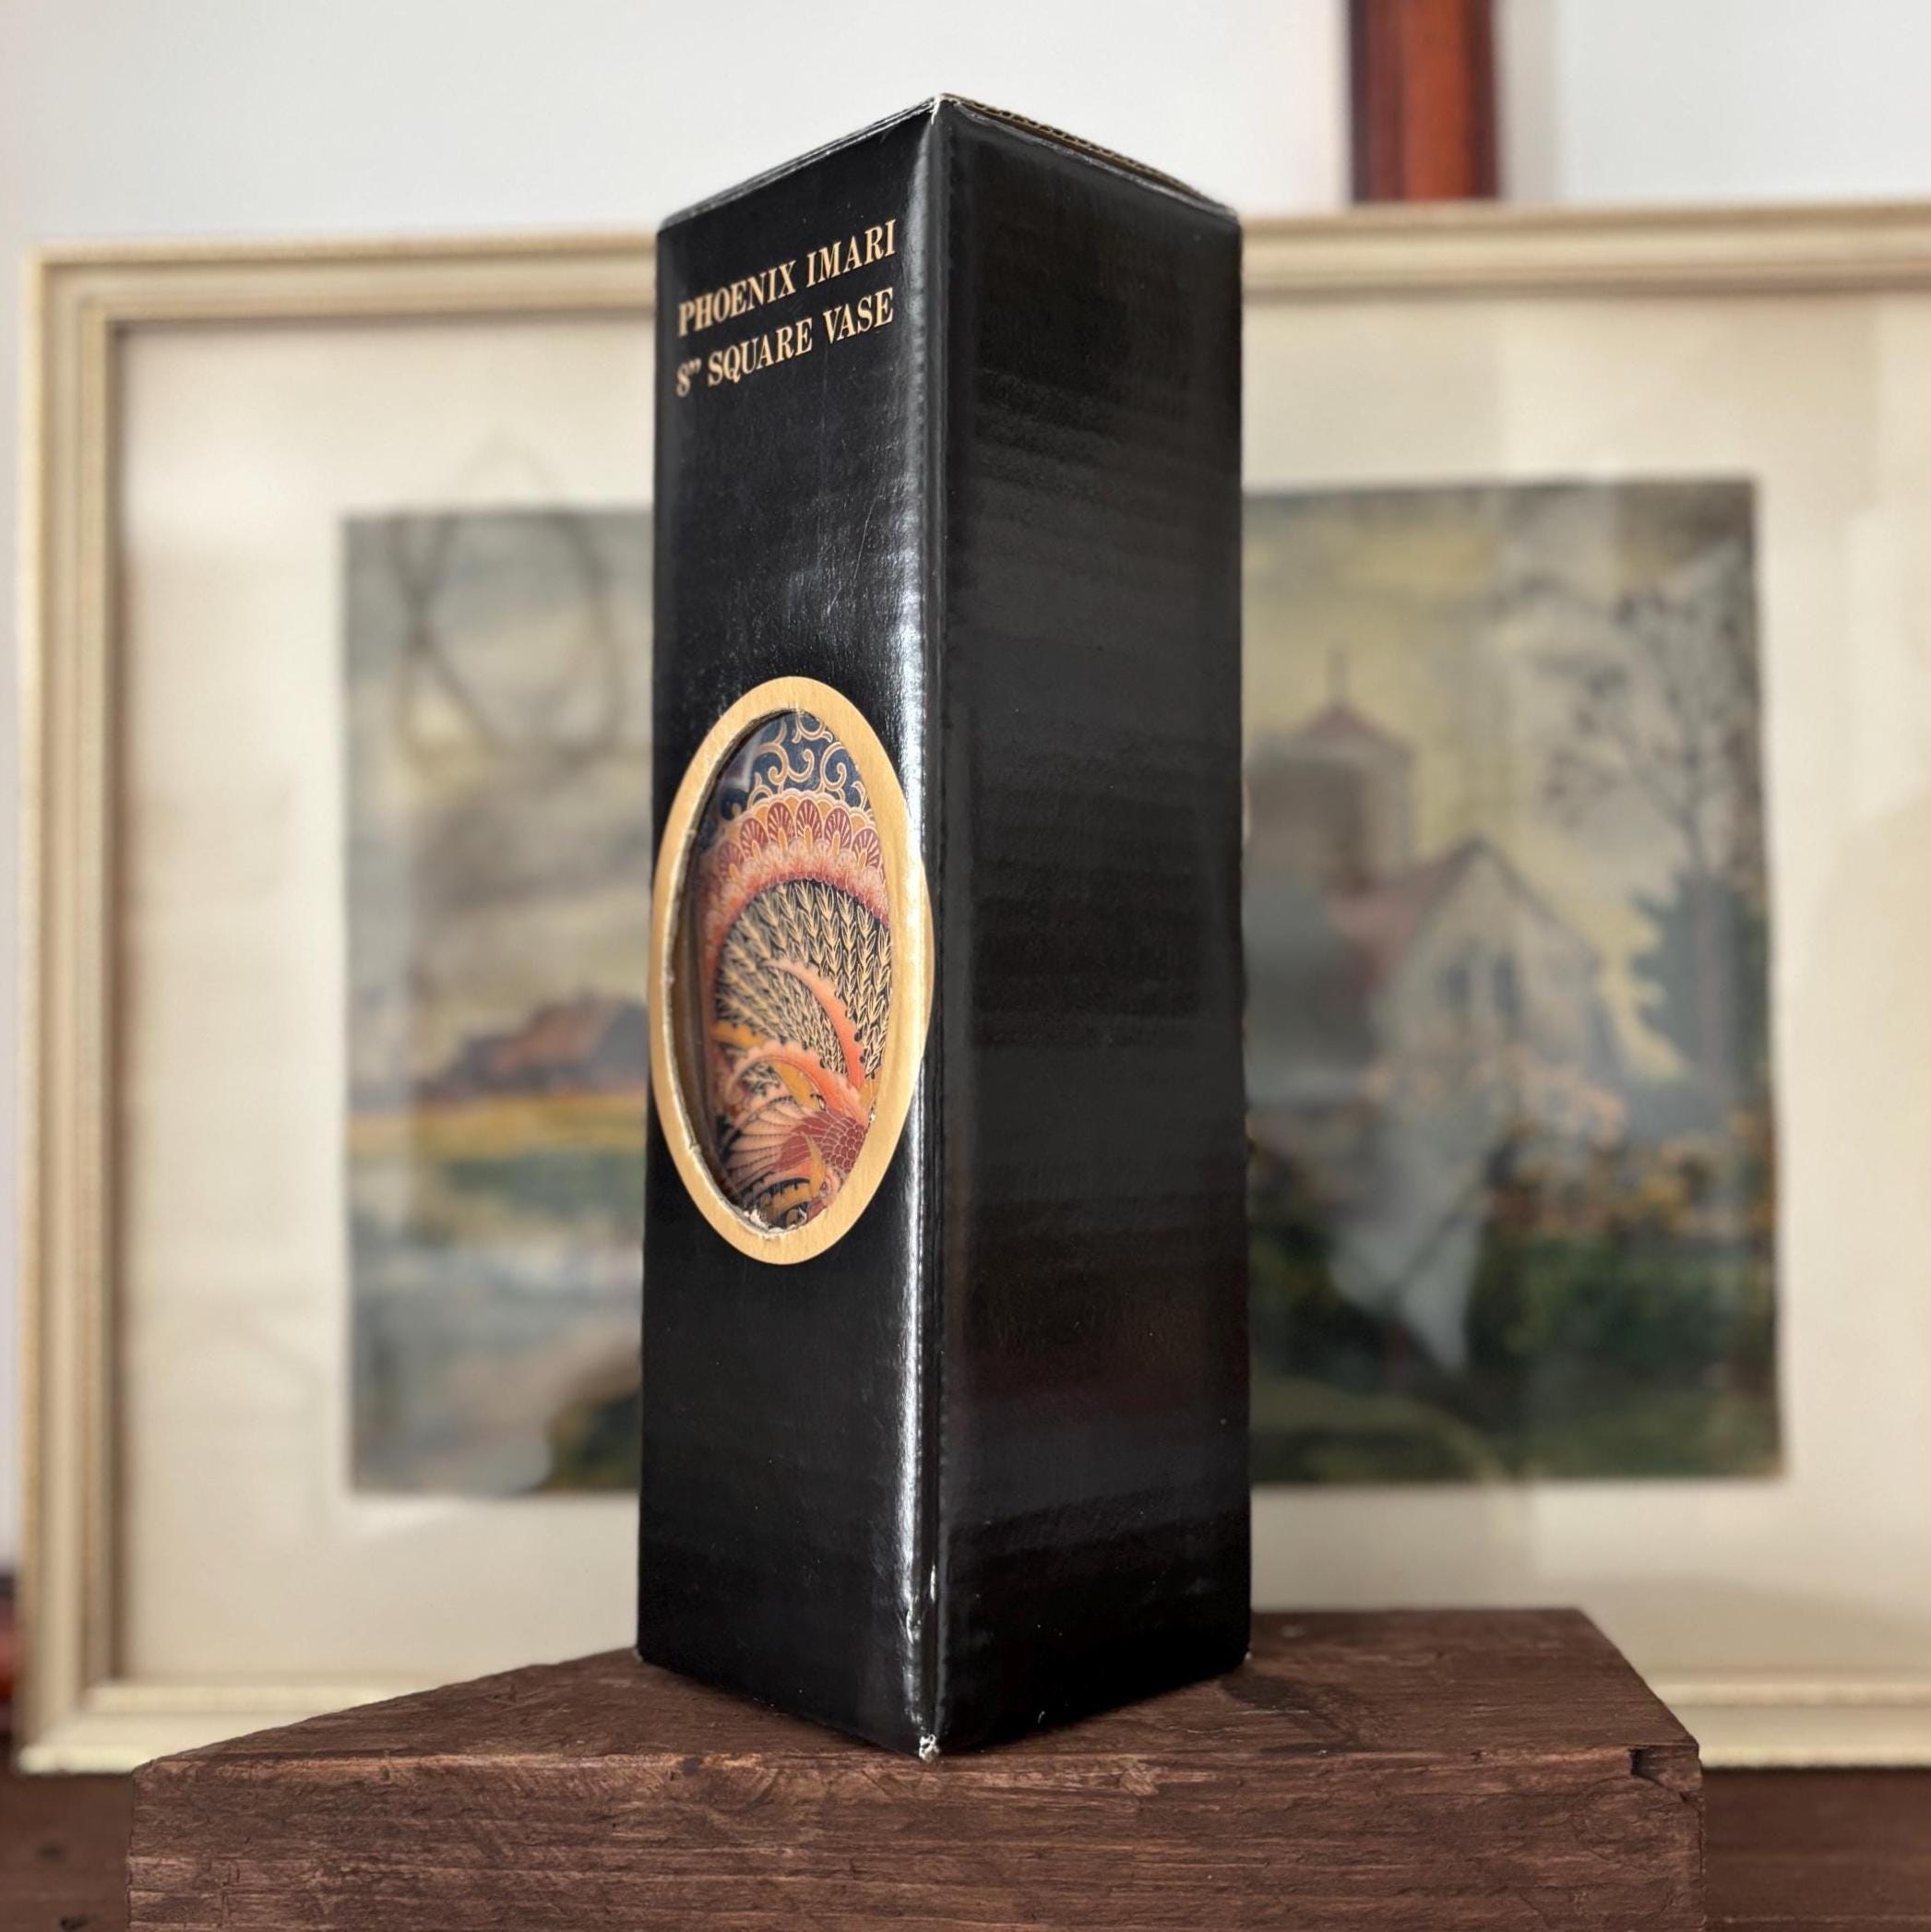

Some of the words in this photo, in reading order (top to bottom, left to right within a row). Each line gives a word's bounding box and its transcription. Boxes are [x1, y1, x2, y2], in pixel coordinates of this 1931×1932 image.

[677, 260, 796, 338] PHOENIX
[805, 219, 897, 288] IMARI
[707, 317, 813, 387] SQUARE
[822, 287, 894, 344] VASE
